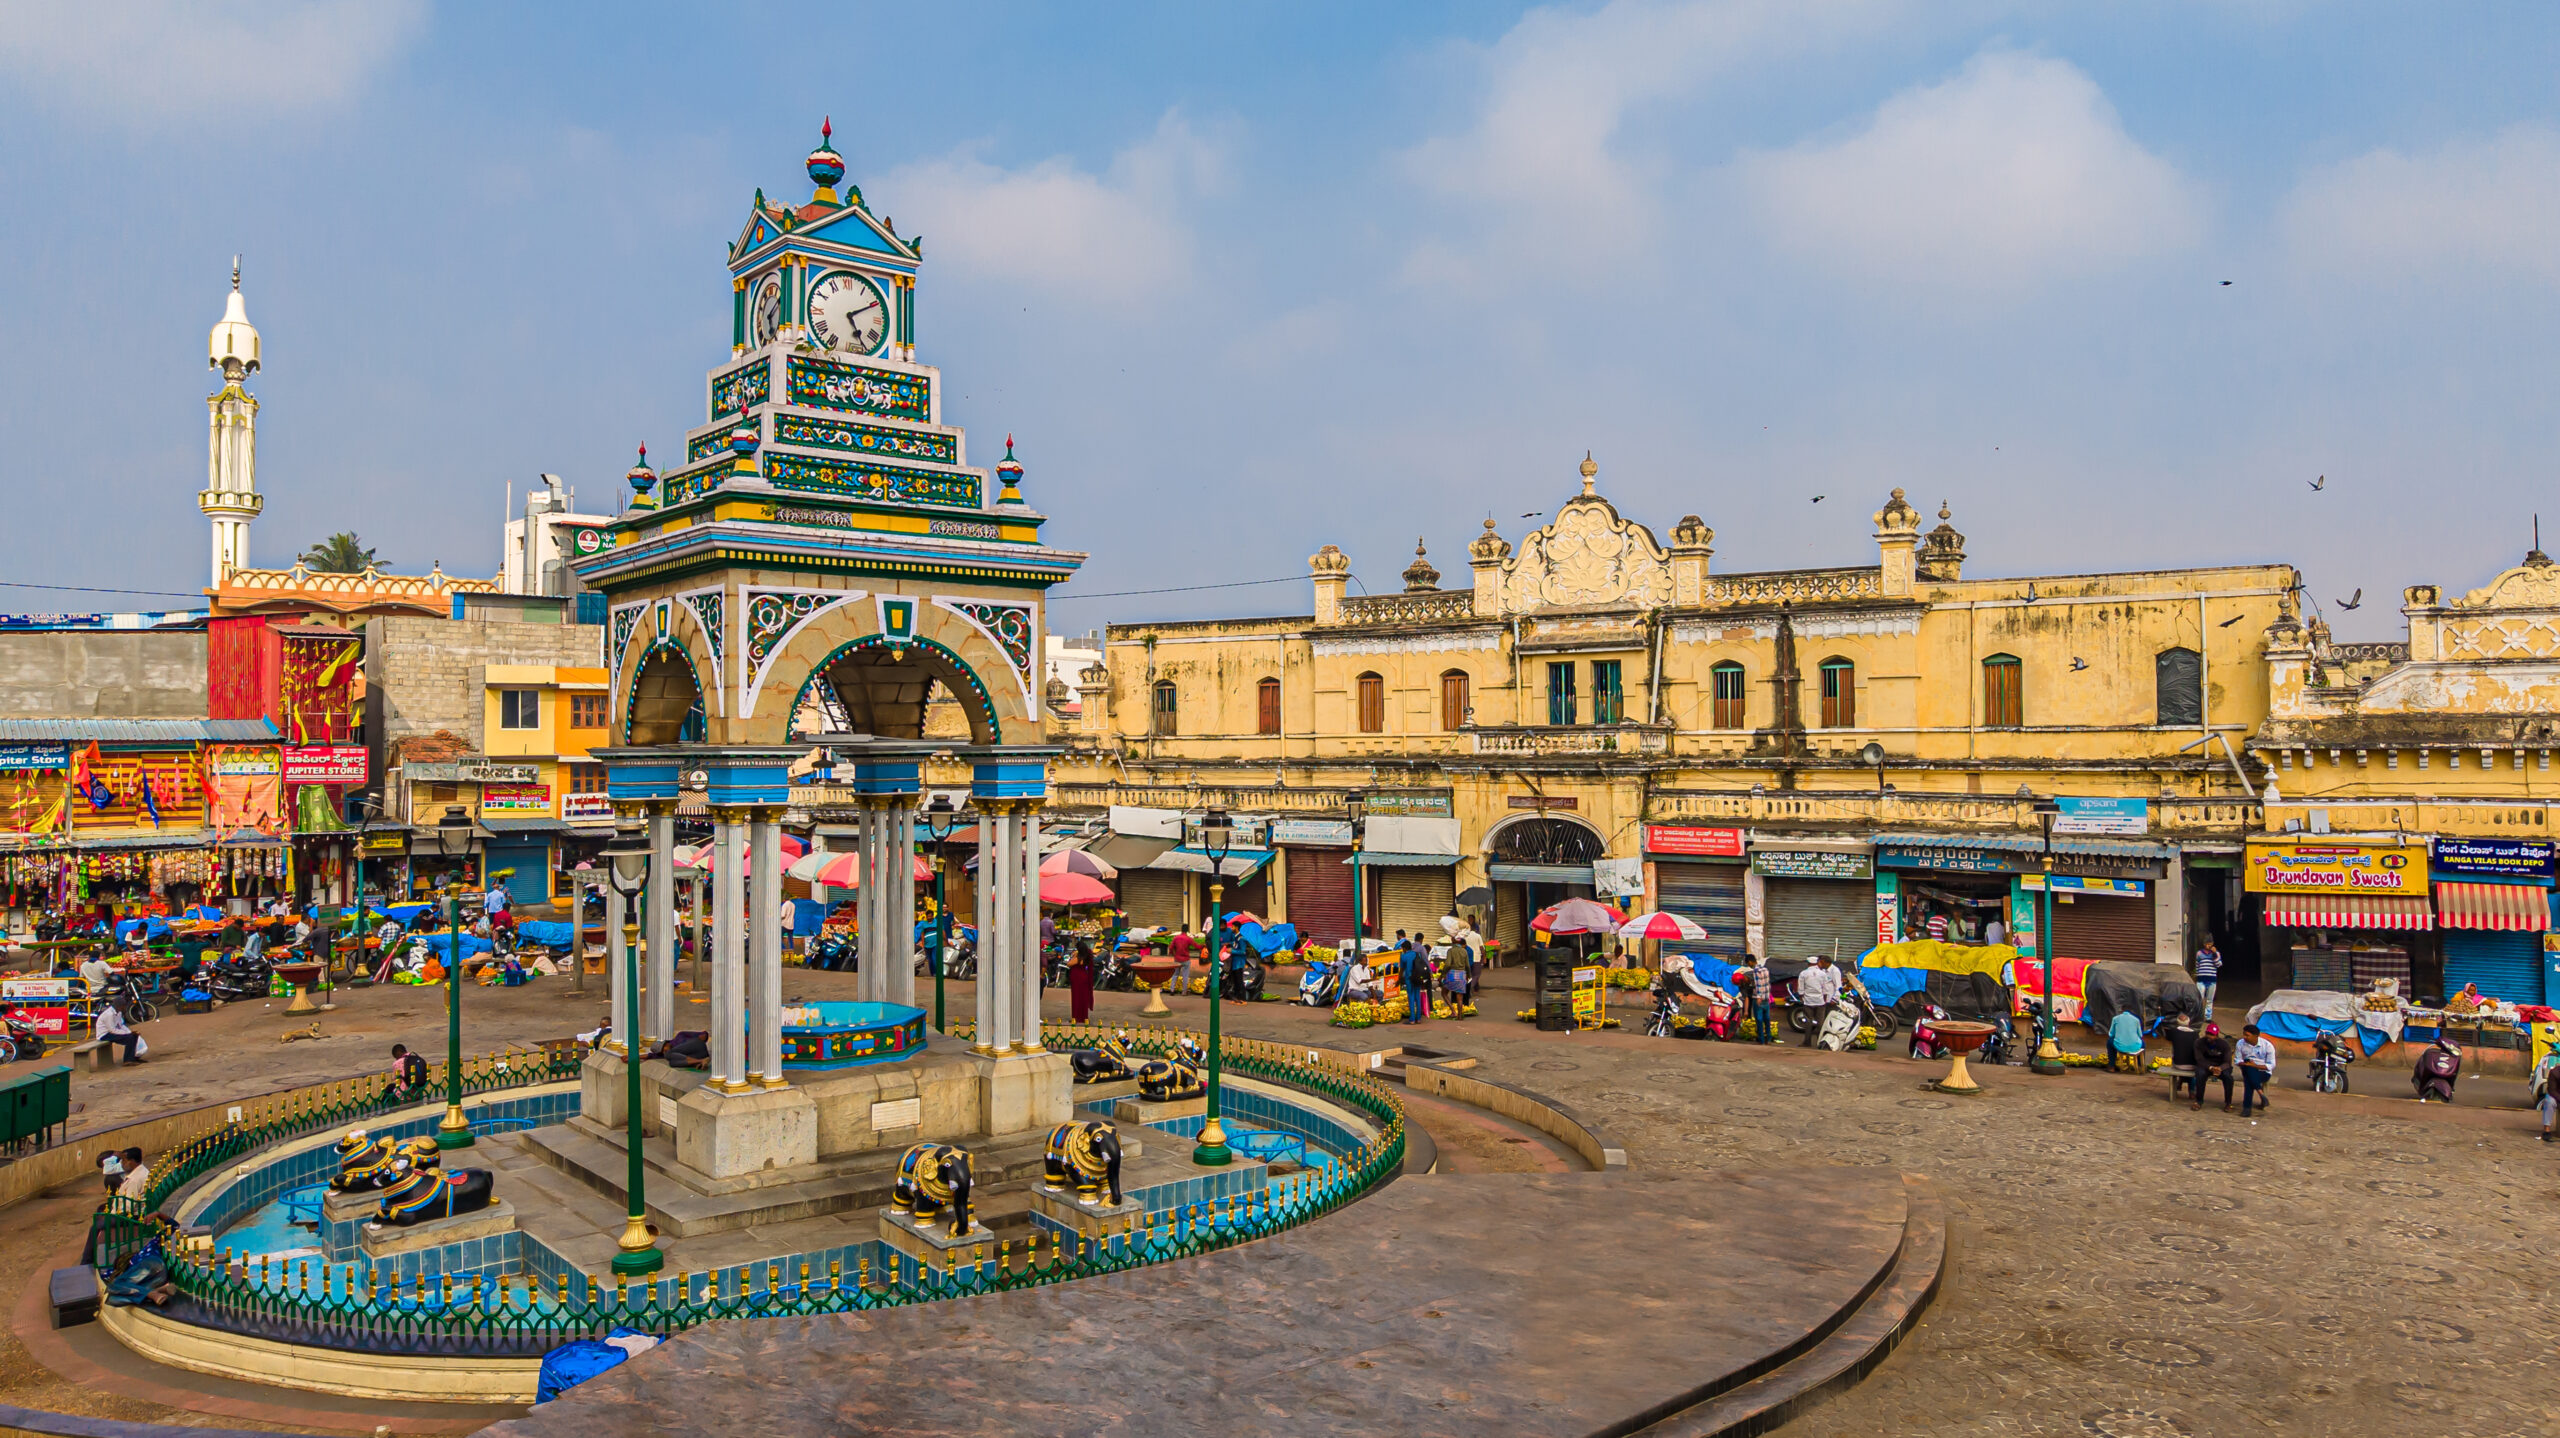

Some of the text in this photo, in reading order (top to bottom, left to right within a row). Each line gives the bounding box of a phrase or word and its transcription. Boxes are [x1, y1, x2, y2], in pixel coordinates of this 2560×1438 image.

[32, 756, 64, 764] Store
[2079, 800, 2118, 810] apsara
[2438, 845, 2457, 853] ರಂಗ
[2460, 845, 2493, 854] ವಿಲಾಸ್
[2024, 852, 2150, 868] WISHANKAR
[2266, 866, 2402, 886] Brundavan Sweets
